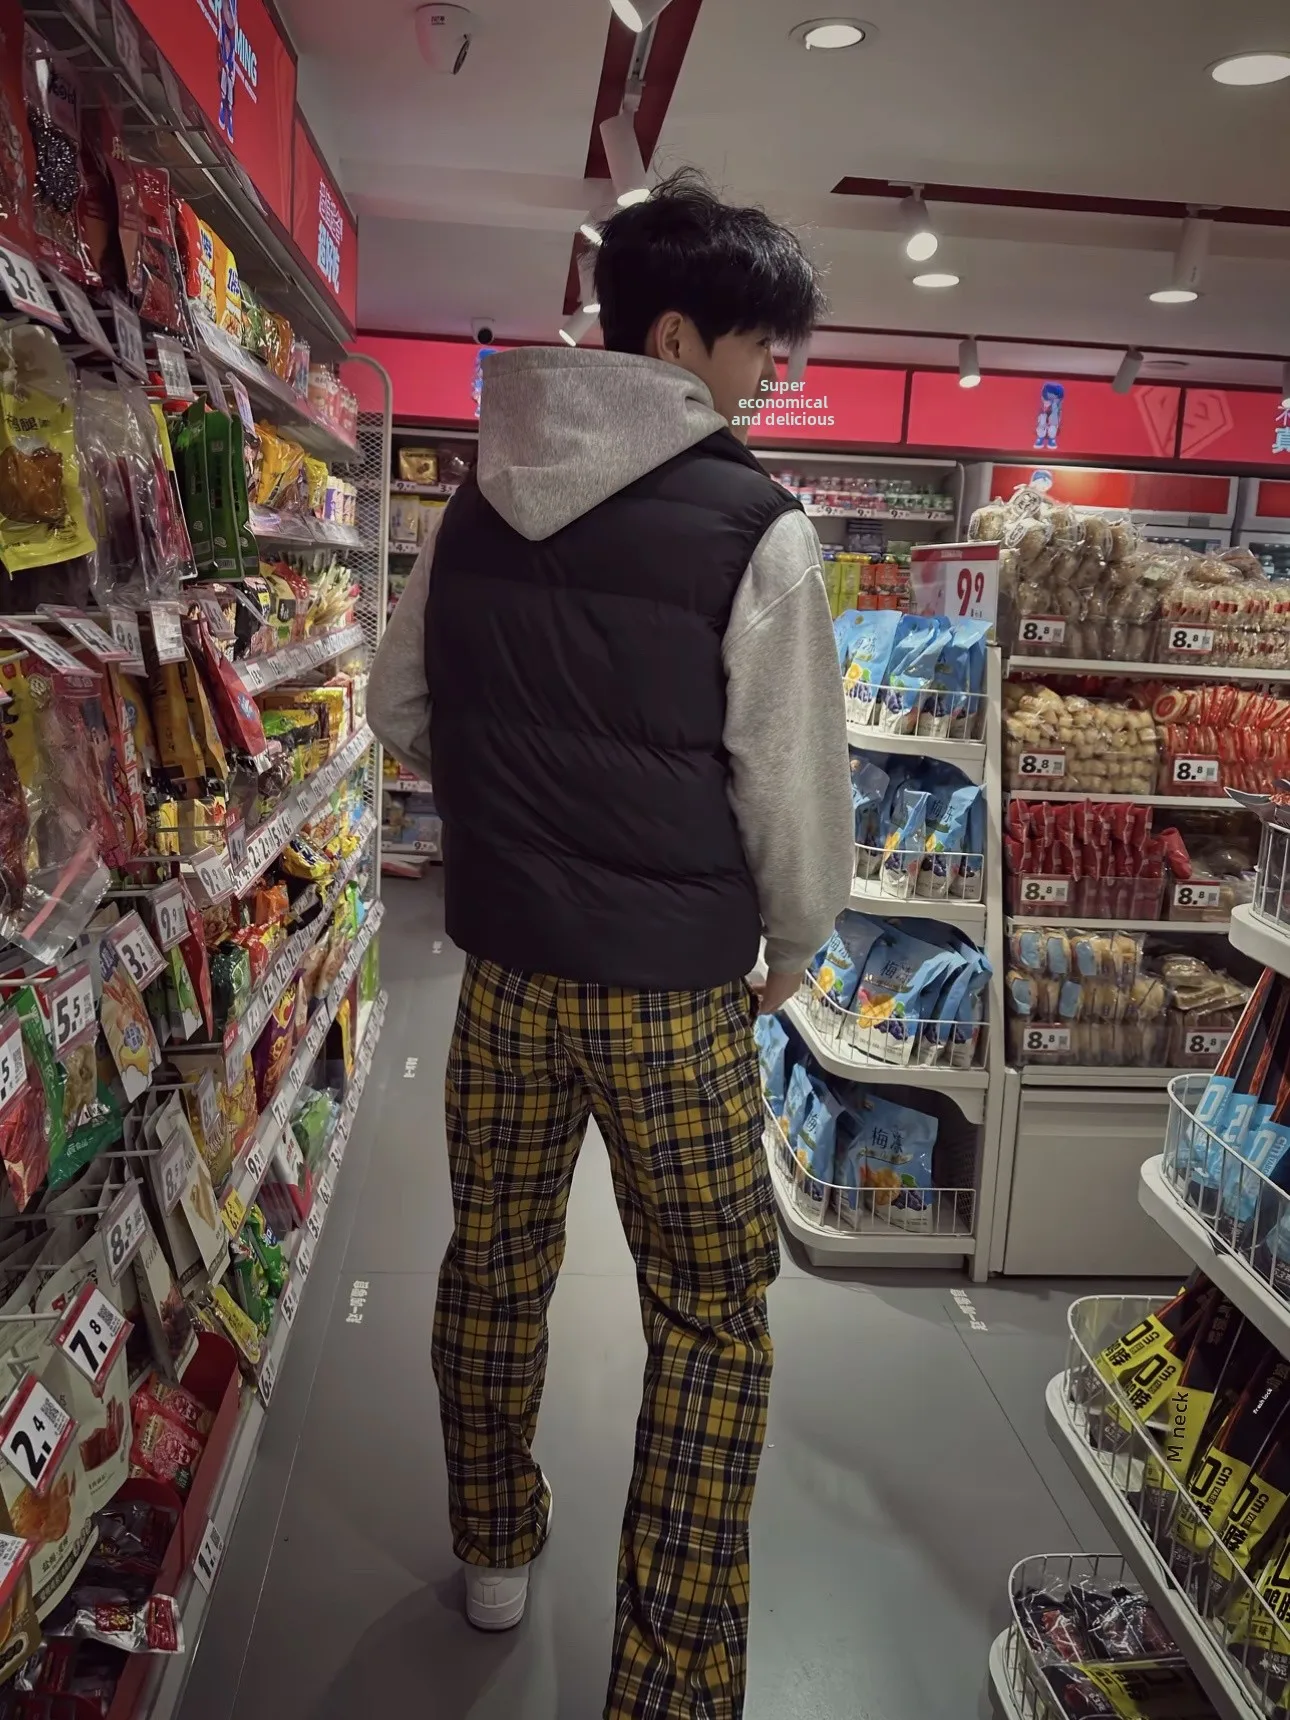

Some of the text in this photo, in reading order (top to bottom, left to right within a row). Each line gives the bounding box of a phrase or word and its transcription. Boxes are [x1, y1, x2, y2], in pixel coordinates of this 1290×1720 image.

[1023, 622, 1050, 640] 8.8
[1172, 630, 1199, 649] 8.8
[1021, 755, 1049, 773] 8.8
[1176, 762, 1203, 780] 8.8
[1024, 882, 1052, 900] 8.8
[1177, 887, 1205, 906] 8.8
[121, 942, 149, 981] 3.2
[56, 996, 81, 1044] 5.5
[1027, 1031, 1055, 1050] 8.8
[1189, 1035, 1217, 1053] 8.8
[110, 1216, 132, 1265] 8.5
[69, 1319, 108, 1374] 7.8
[1143, 1331, 1160, 1345] cm
[1158, 1365, 1177, 1382] cm
[10, 1415, 53, 1481] 2.4
[1218, 1466, 1233, 1487] cm
[1250, 1493, 1270, 1514] cm
[198, 1542, 215, 1579] 1.7
